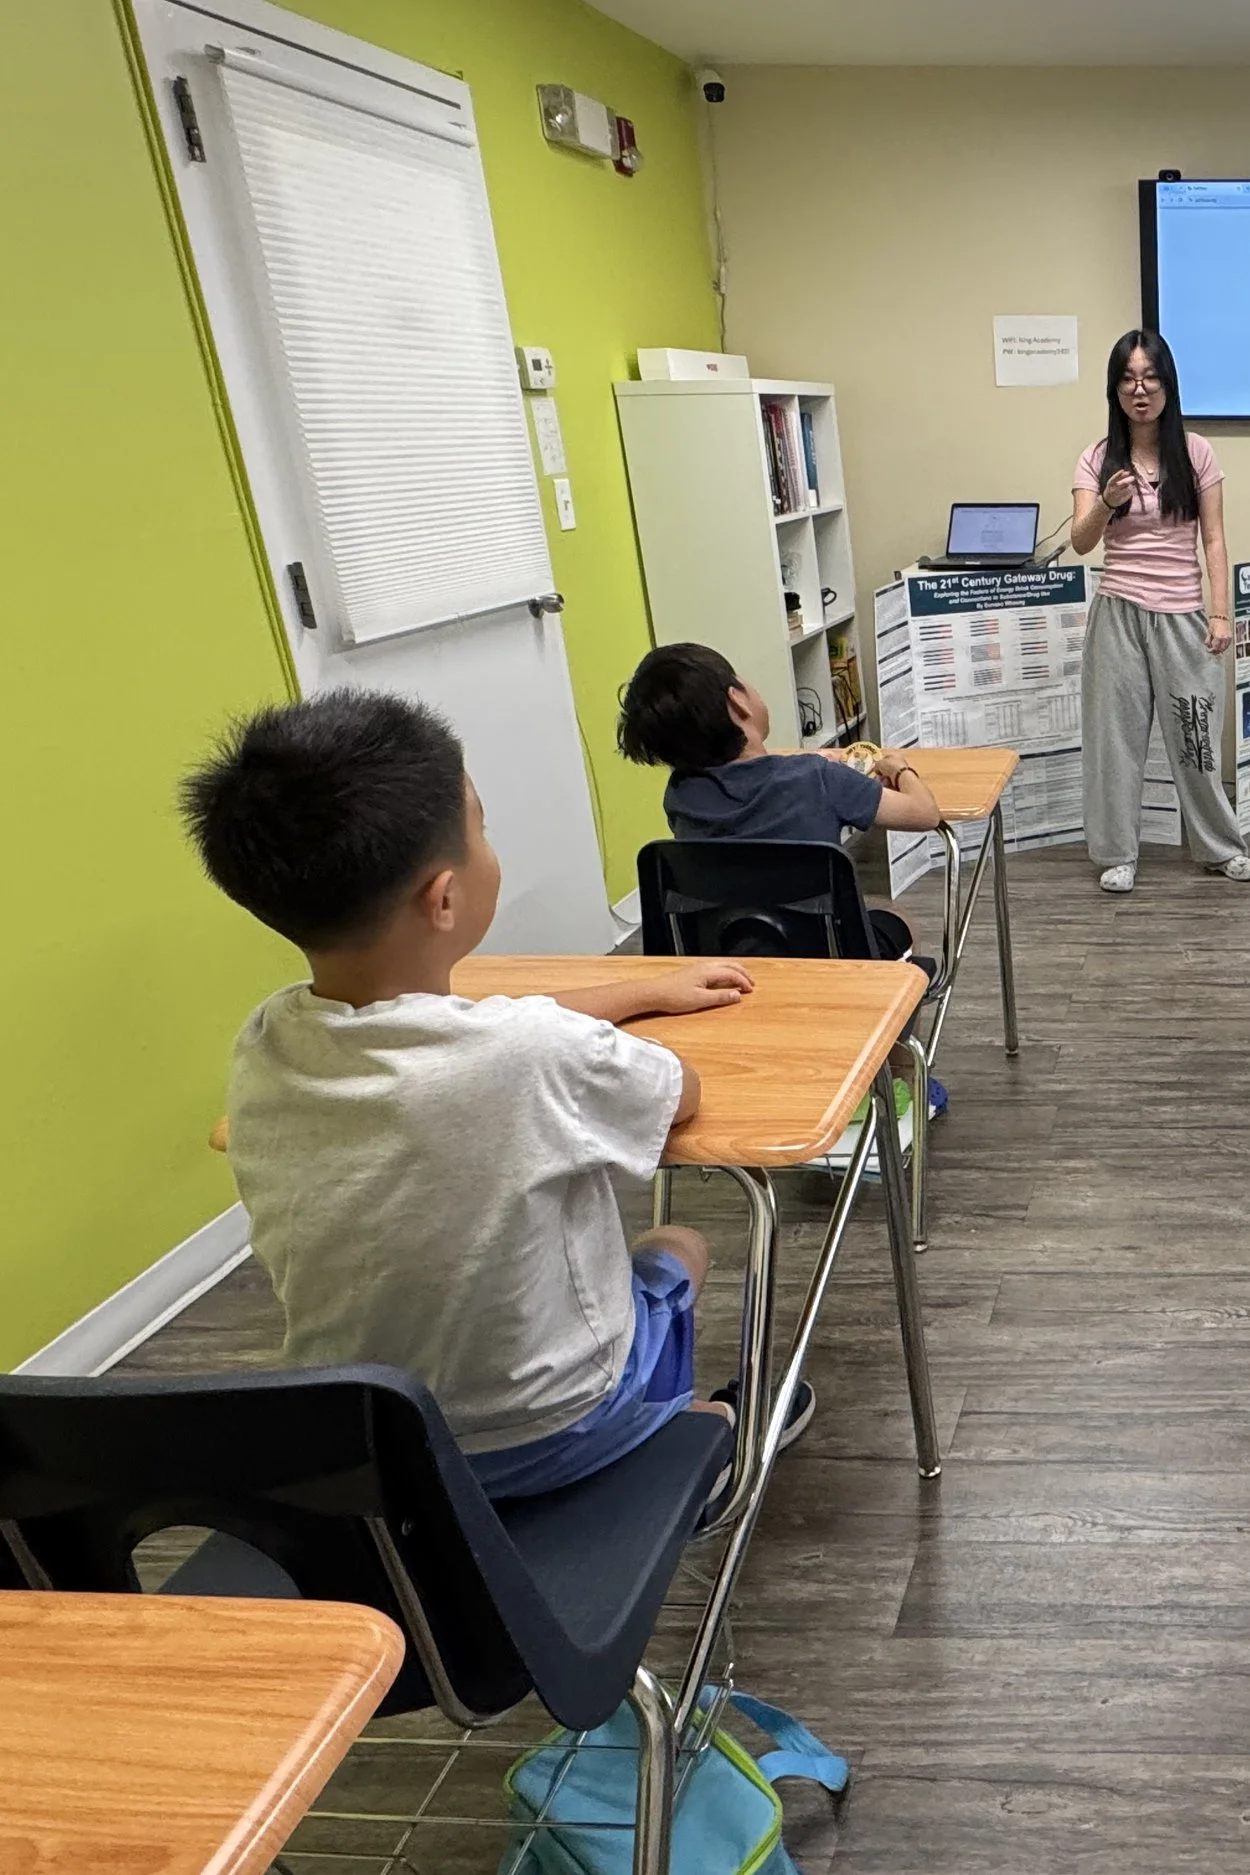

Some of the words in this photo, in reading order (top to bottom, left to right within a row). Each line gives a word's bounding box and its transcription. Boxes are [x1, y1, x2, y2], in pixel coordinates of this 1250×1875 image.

[917, 580, 938, 591] The
[940, 576, 959, 589] 21st
[961, 575, 1000, 590] Century
[1003, 572, 1046, 586] Gateway
[1049, 570, 1076, 583] Drug:
[933, 591, 960, 599] Exploring
[996, 586, 1014, 595] Energy
[948, 597, 959, 605] and
